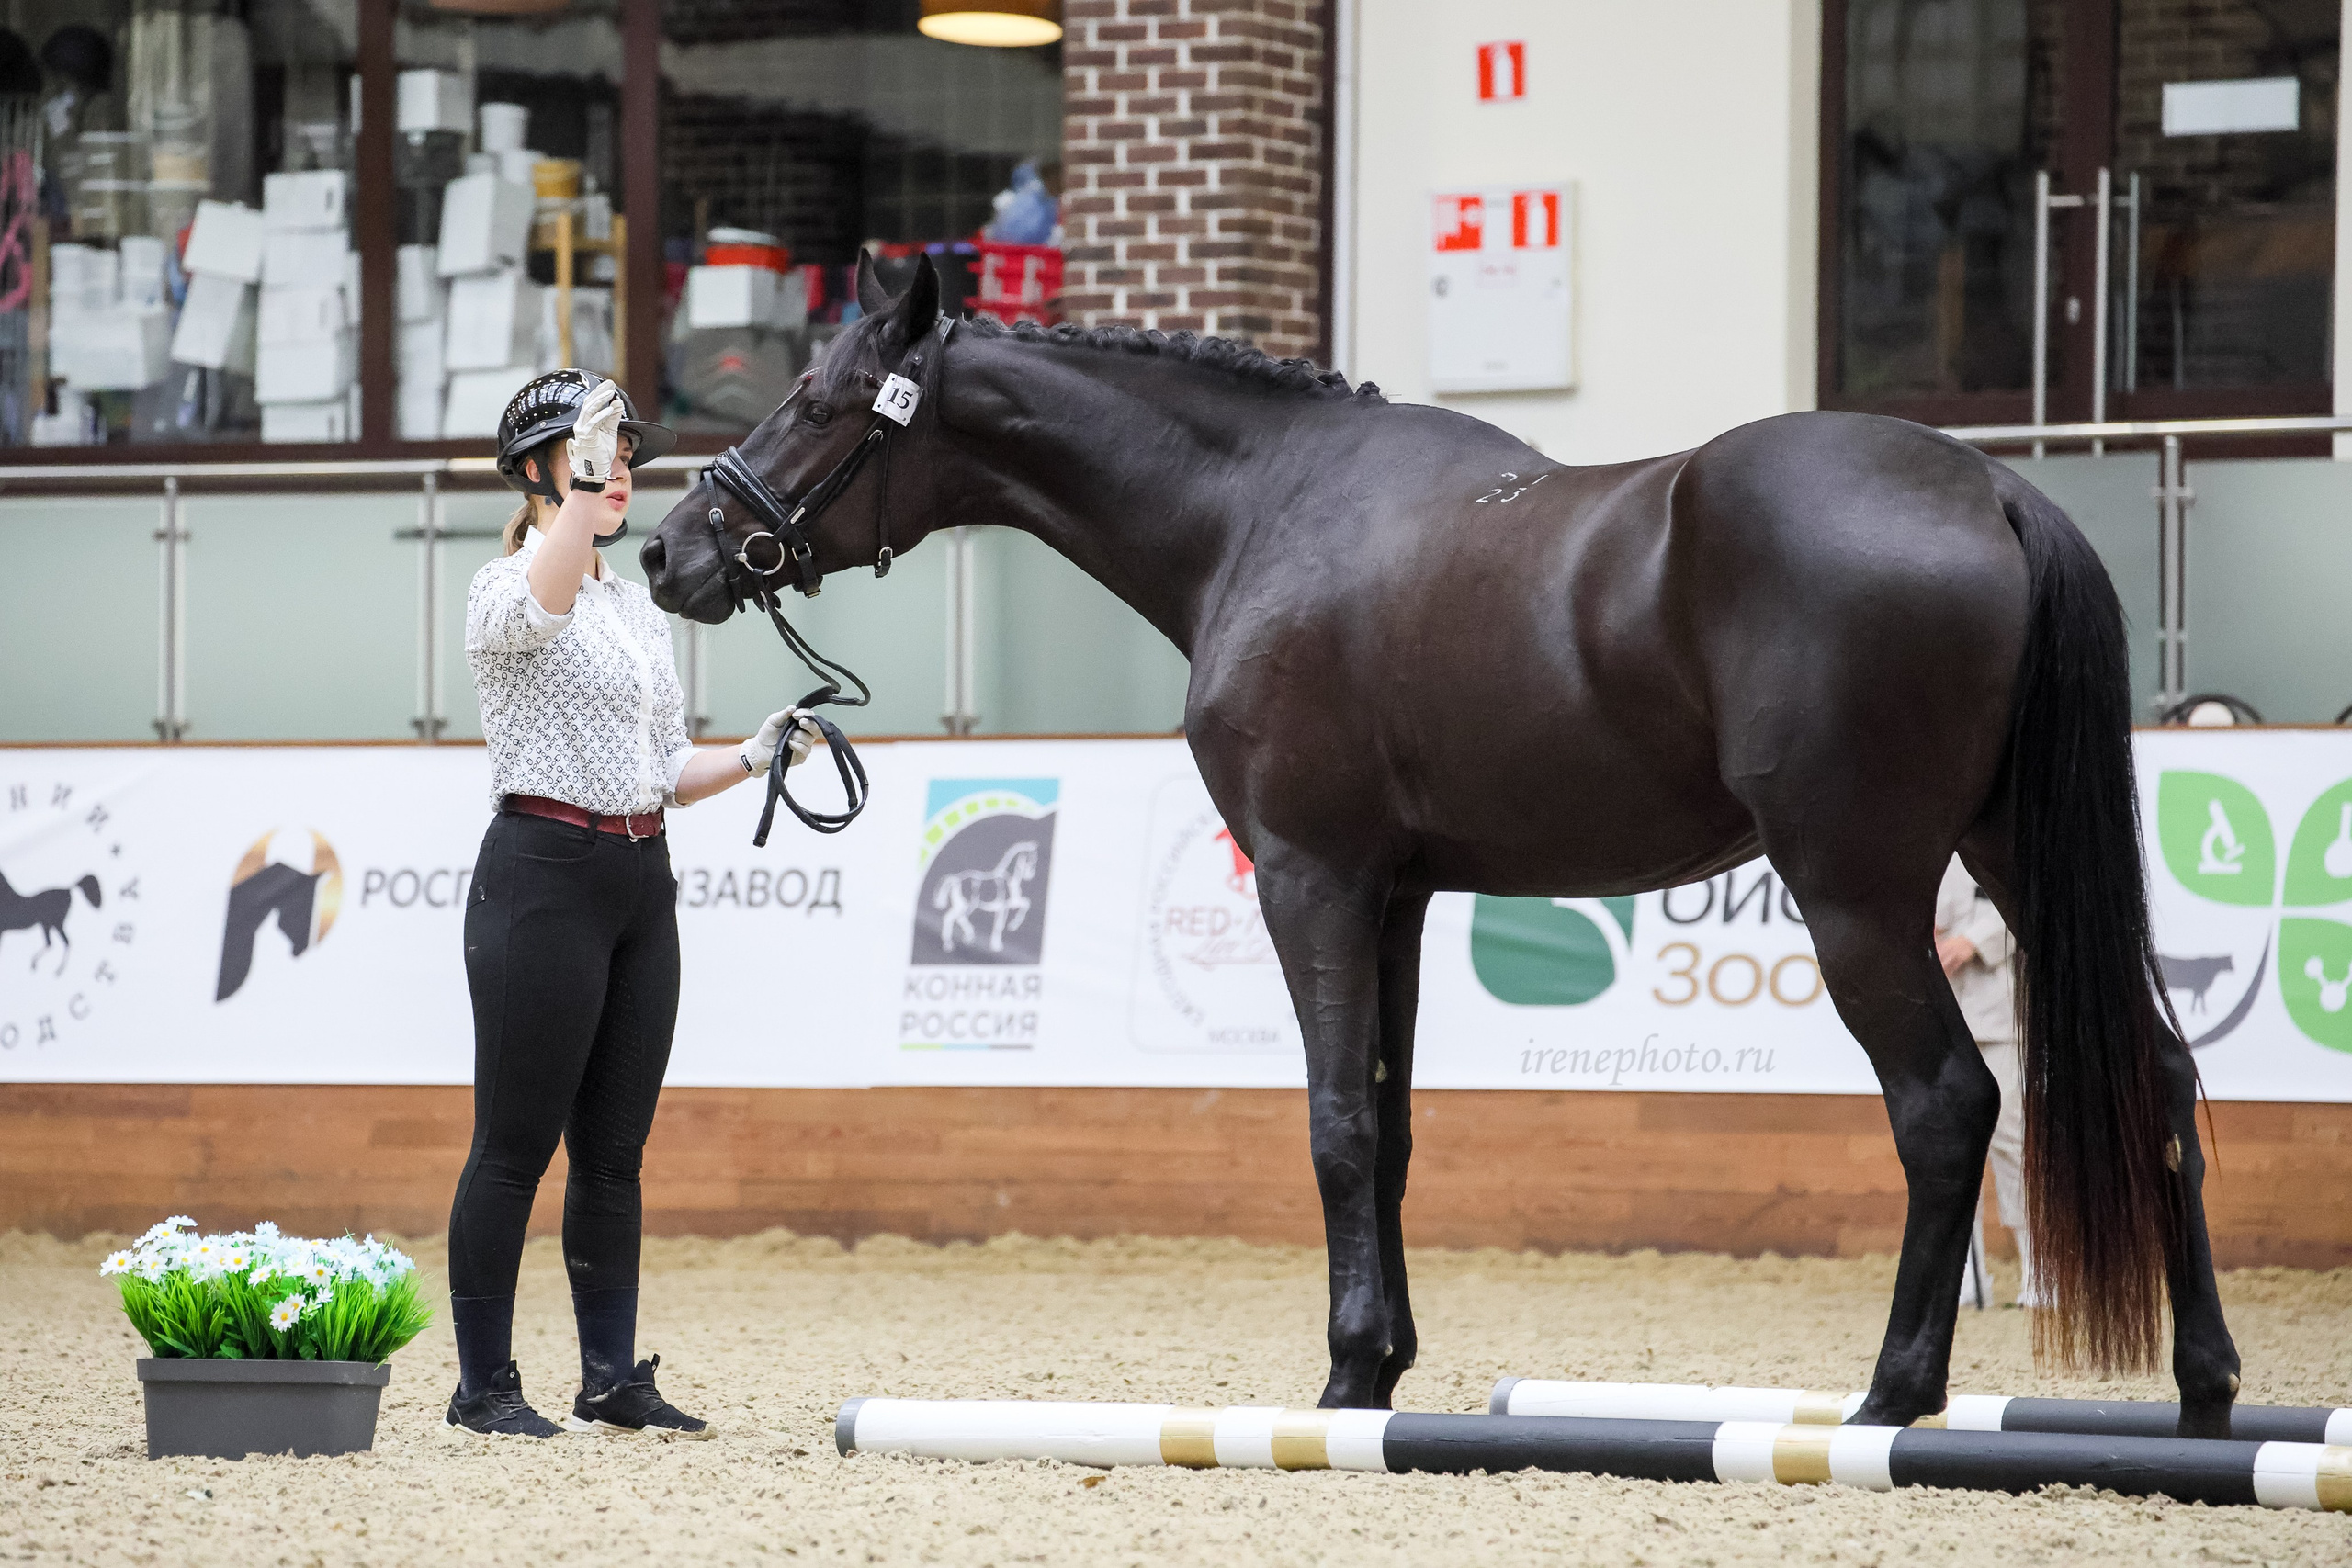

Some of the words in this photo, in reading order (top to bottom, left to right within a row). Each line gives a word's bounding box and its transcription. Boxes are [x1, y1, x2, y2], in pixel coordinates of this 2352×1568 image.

[887, 387, 913, 410] 15
[903, 973, 1042, 1000] КОННАЯ
[899, 1010, 1039, 1039] РОССИЯ
